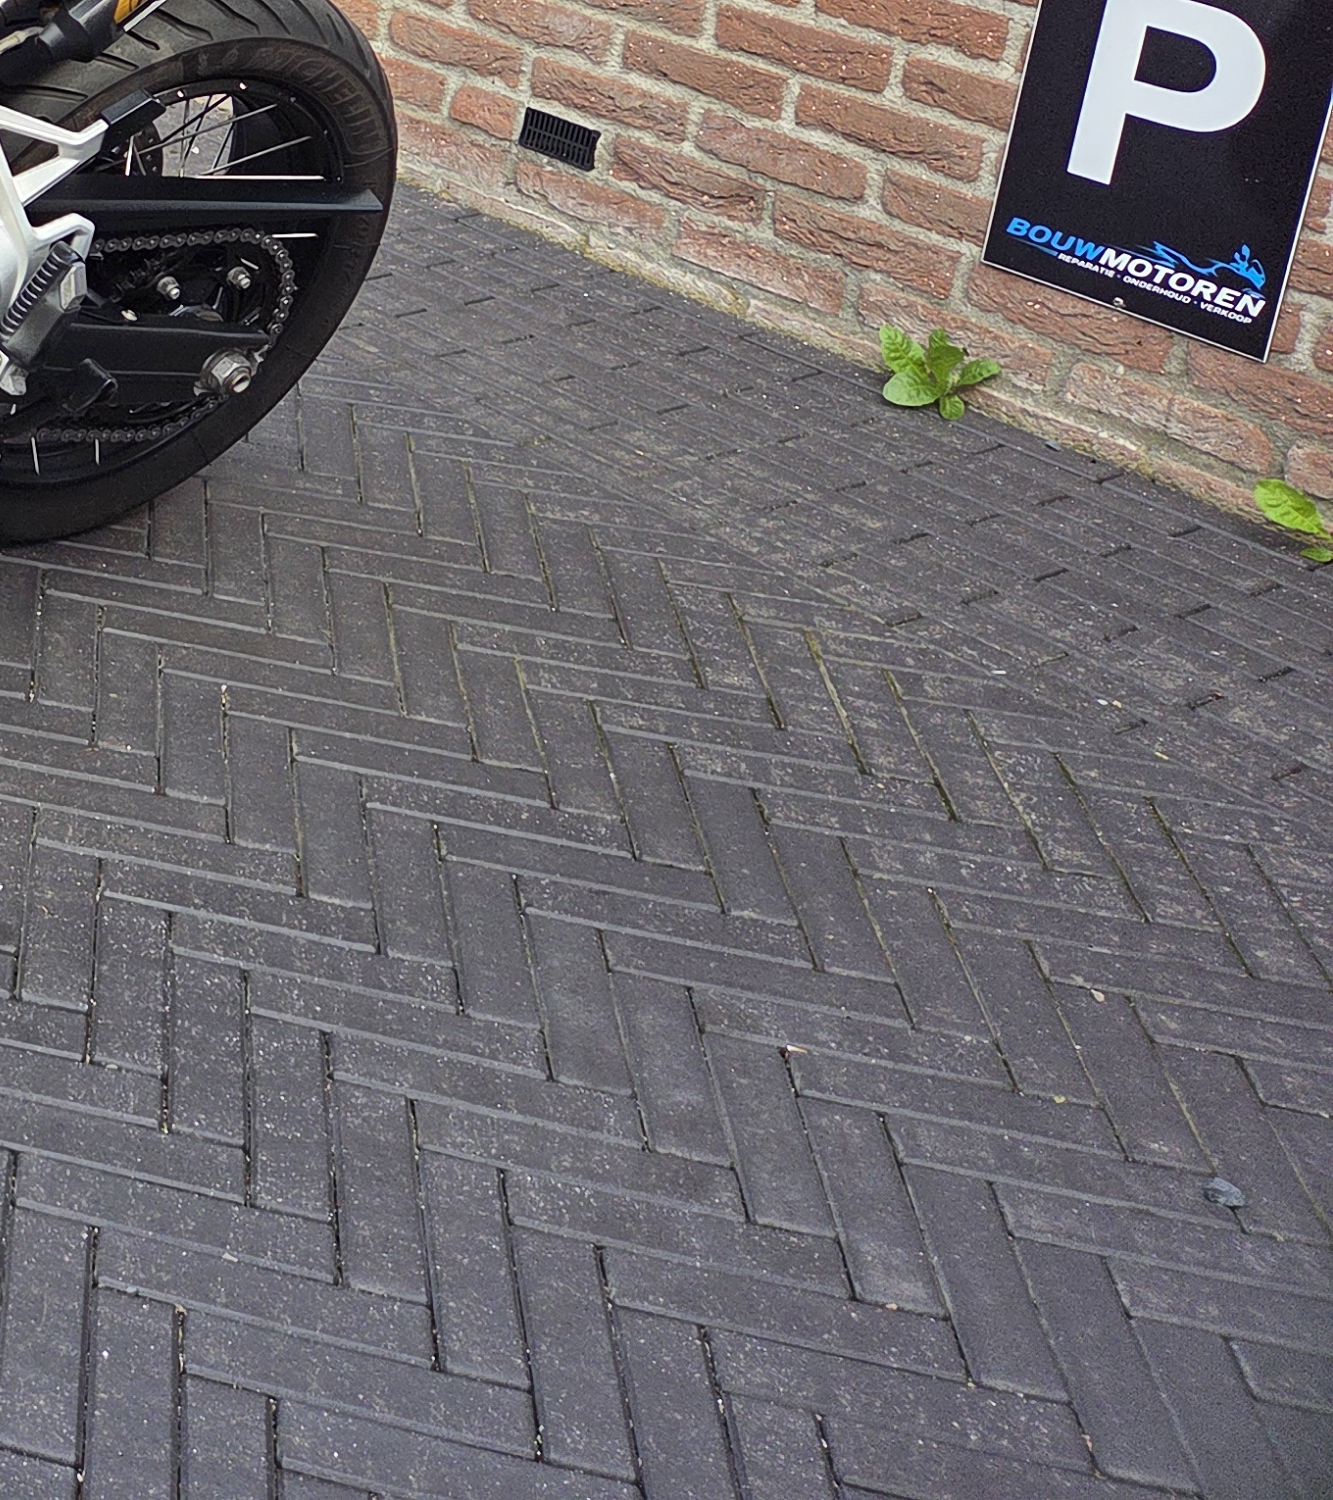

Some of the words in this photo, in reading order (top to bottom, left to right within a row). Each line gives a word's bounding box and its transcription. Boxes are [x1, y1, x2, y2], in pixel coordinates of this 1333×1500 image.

[1057, 252, 1115, 278] REPARATIE
[1123, 275, 1192, 305] ONDERHOUD
[1200, 301, 1253, 325] VERKOOP
